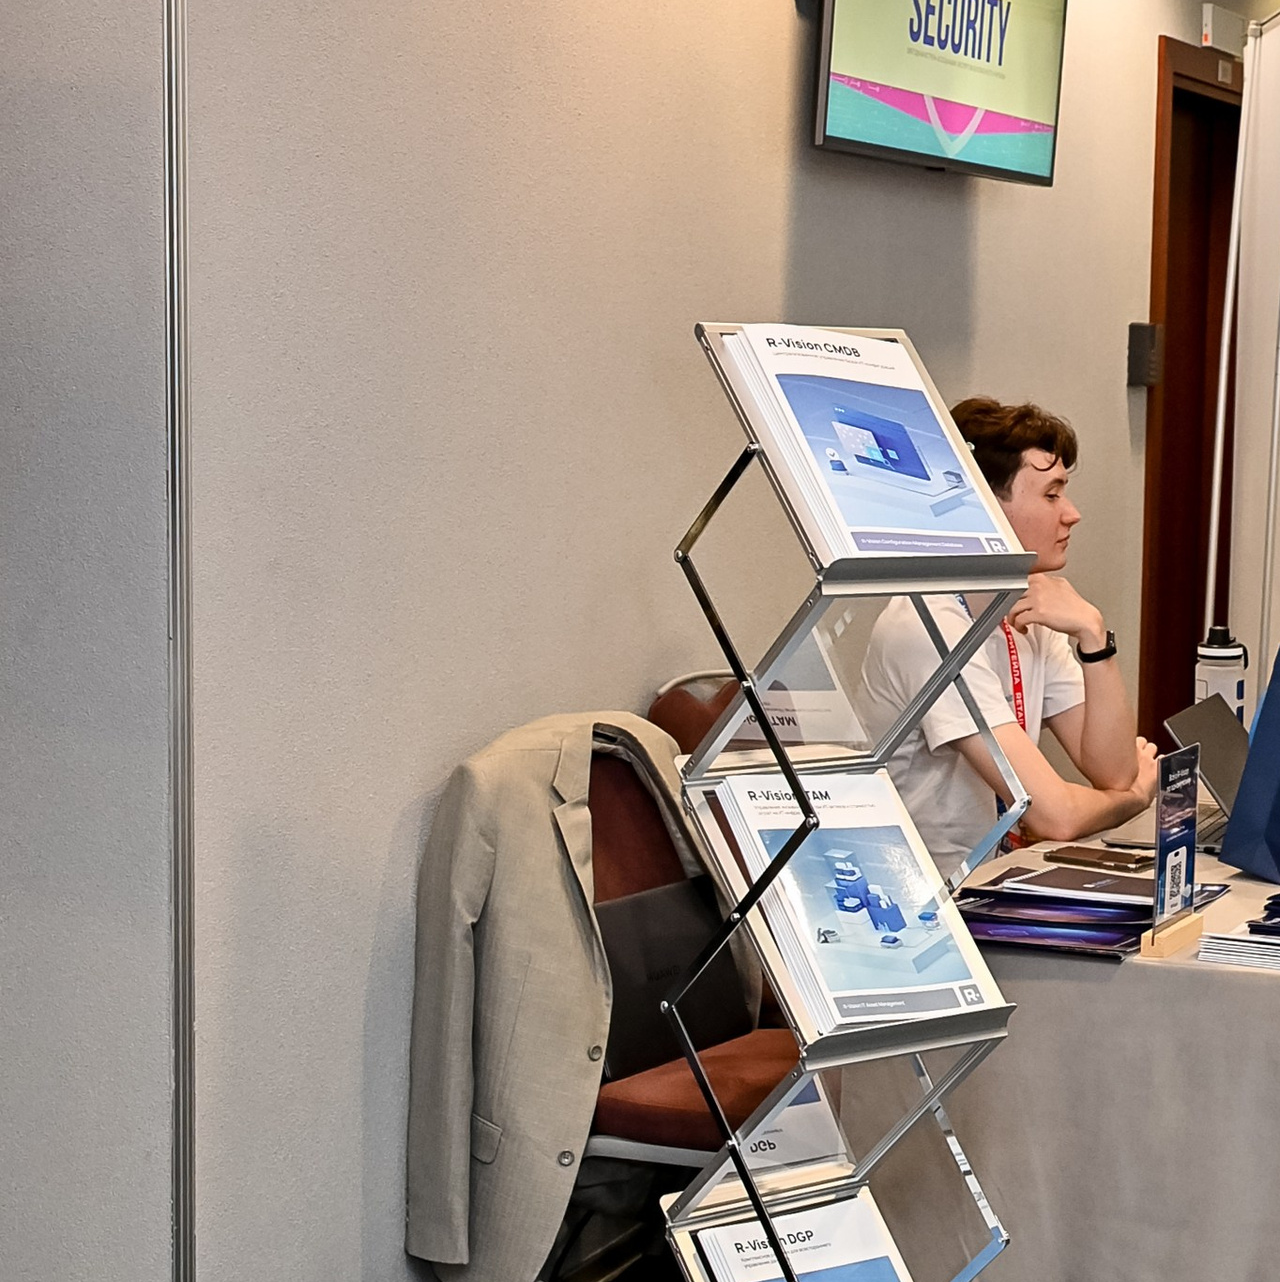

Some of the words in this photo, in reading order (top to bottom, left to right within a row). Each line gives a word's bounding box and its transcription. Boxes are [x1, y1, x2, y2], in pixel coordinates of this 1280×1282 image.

[766, 338, 823, 352] R-Vision
[824, 343, 861, 357] CMDB
[804, 790, 831, 801] TAM
[734, 1238, 787, 1254] R-Visn
[787, 1230, 814, 1245] DGP
